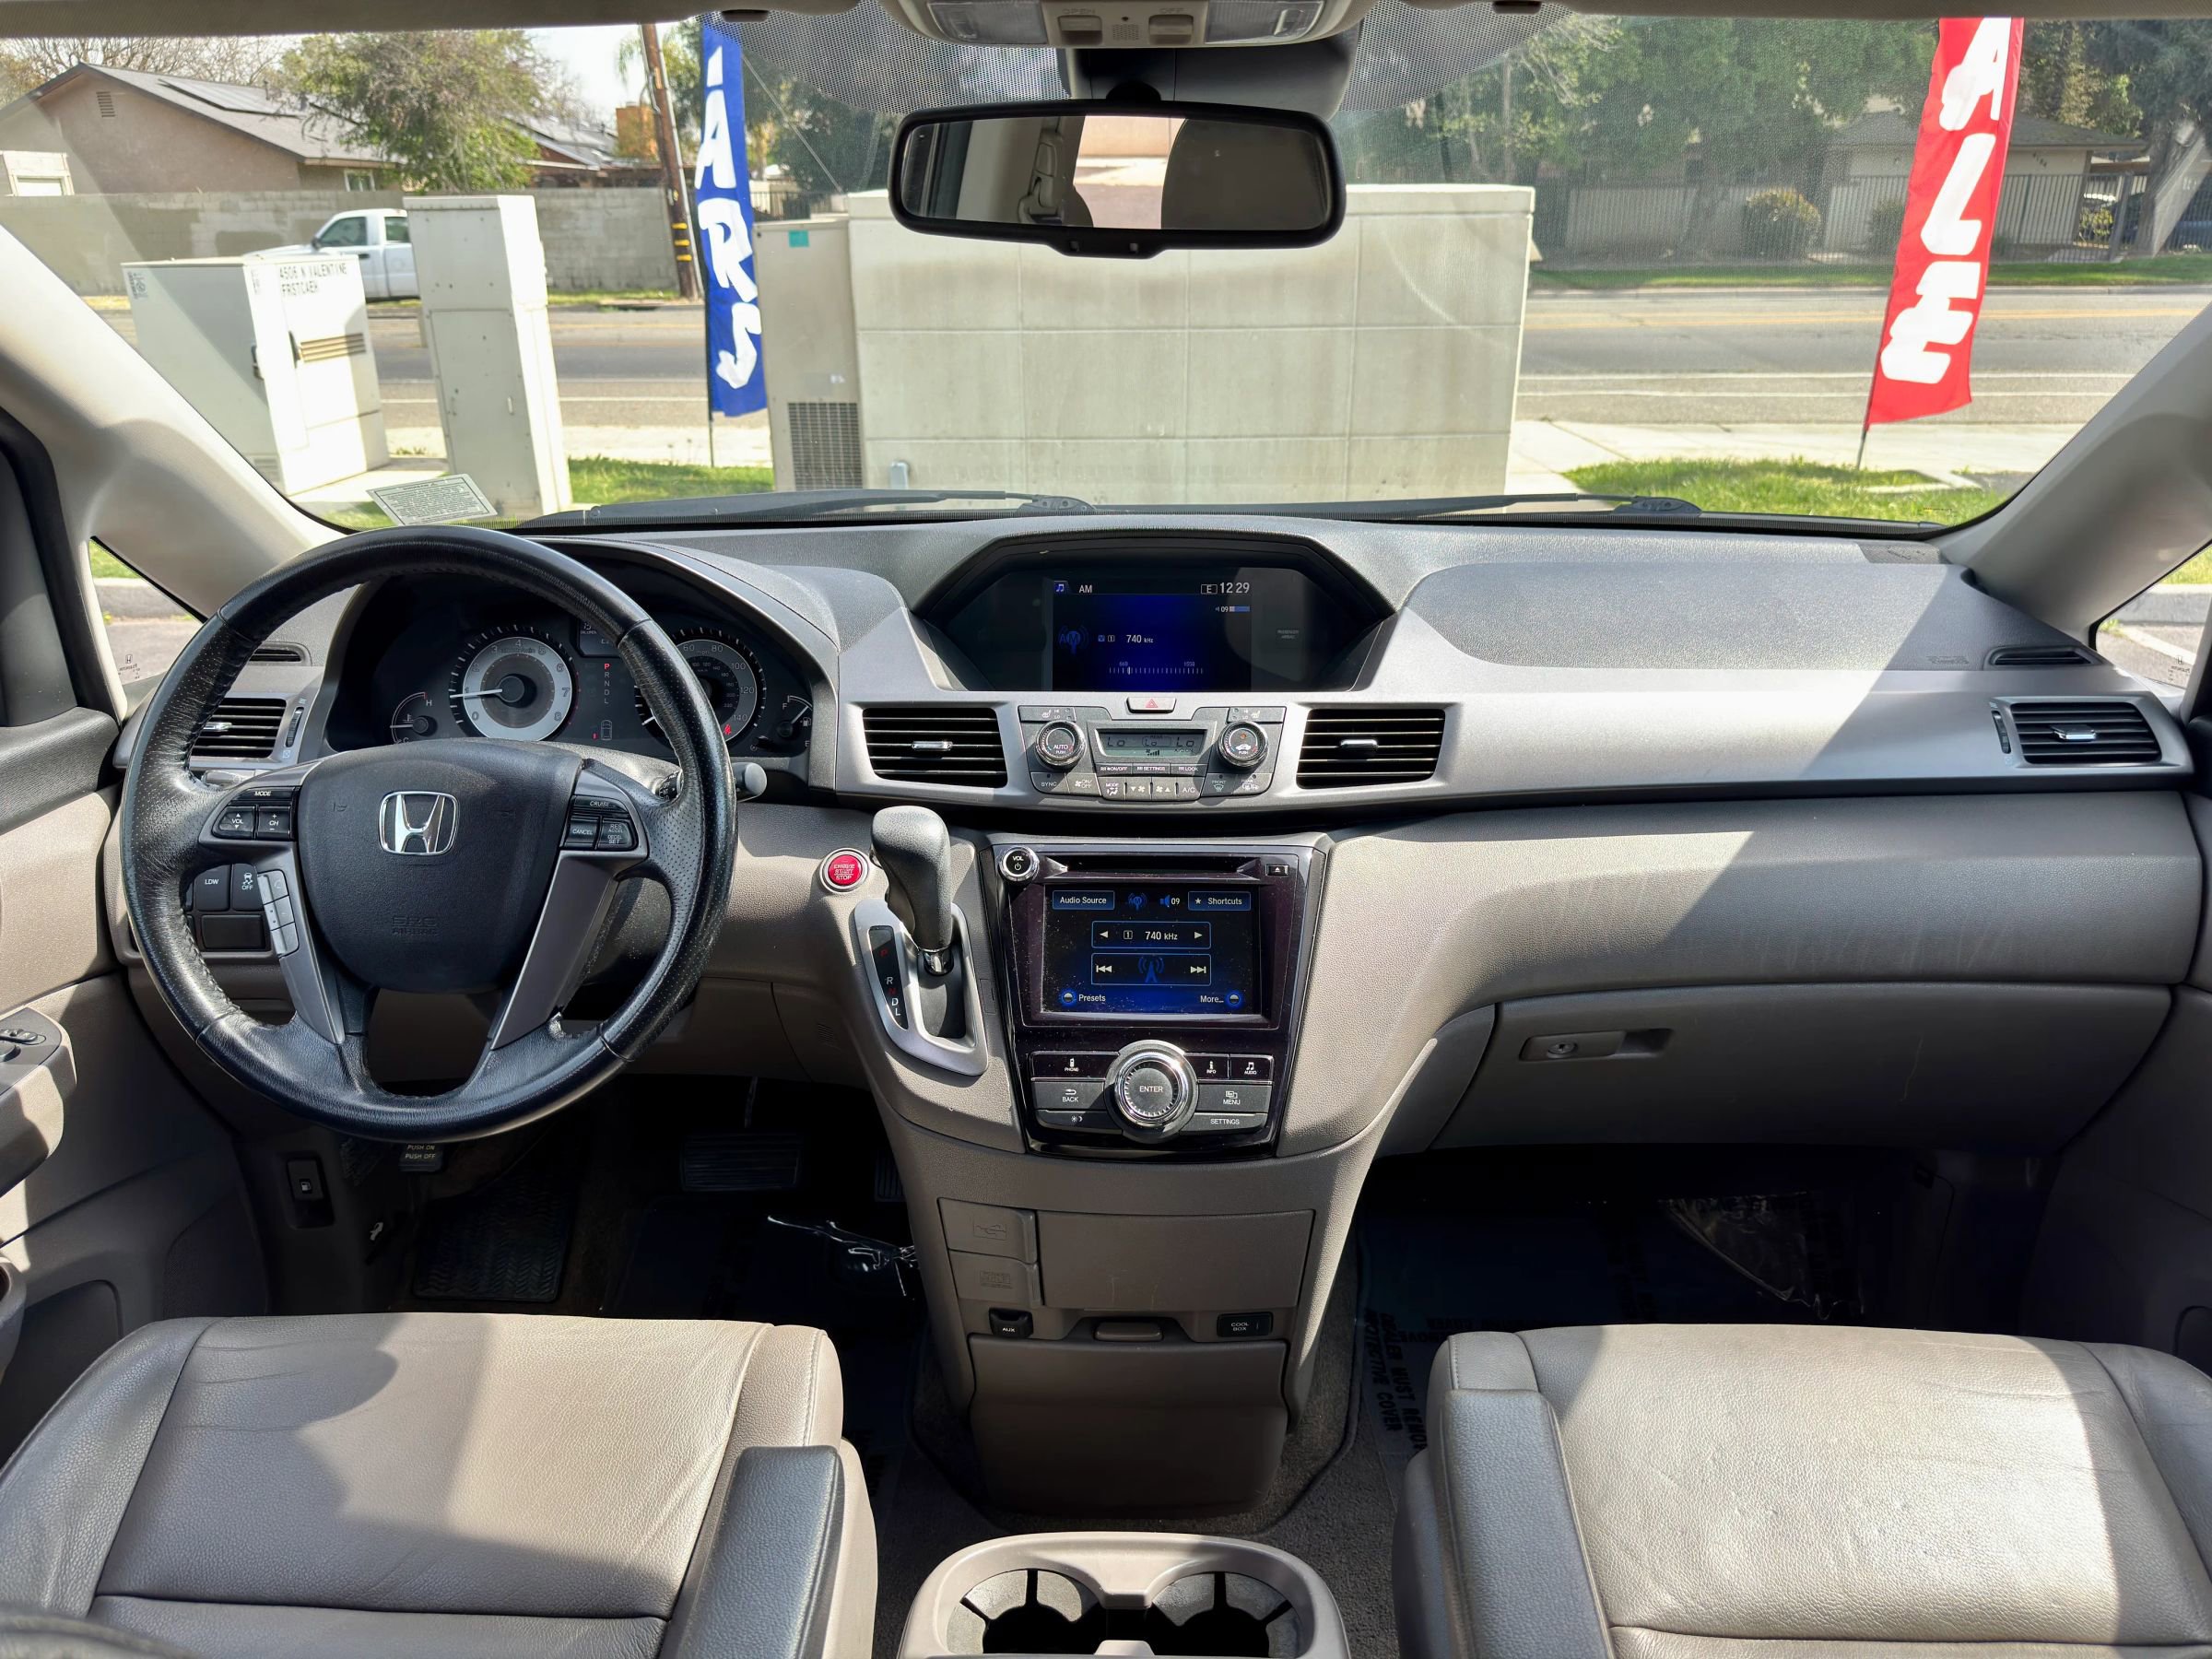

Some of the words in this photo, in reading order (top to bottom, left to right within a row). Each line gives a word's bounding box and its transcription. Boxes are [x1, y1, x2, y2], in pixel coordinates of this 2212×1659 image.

[694, 46, 762, 389] ARS
[1078, 584, 1093, 594] AM
[1126, 634, 1142, 643] 740
[740, 686, 755, 694] 120
[472, 712, 478, 720] 0
[1060, 896, 1080, 904] Audio
[1081, 896, 1107, 904] Source
[1207, 897, 1242, 906] Shortcuts
[1145, 932, 1161, 940] 740
[886, 976, 894, 984] R
[891, 997, 899, 1006] D
[895, 1007, 901, 1016] L
[1078, 994, 1106, 1002] Presets
[1391, 1367, 1416, 1400] MUST
[1377, 1393, 1403, 1431] COVER
